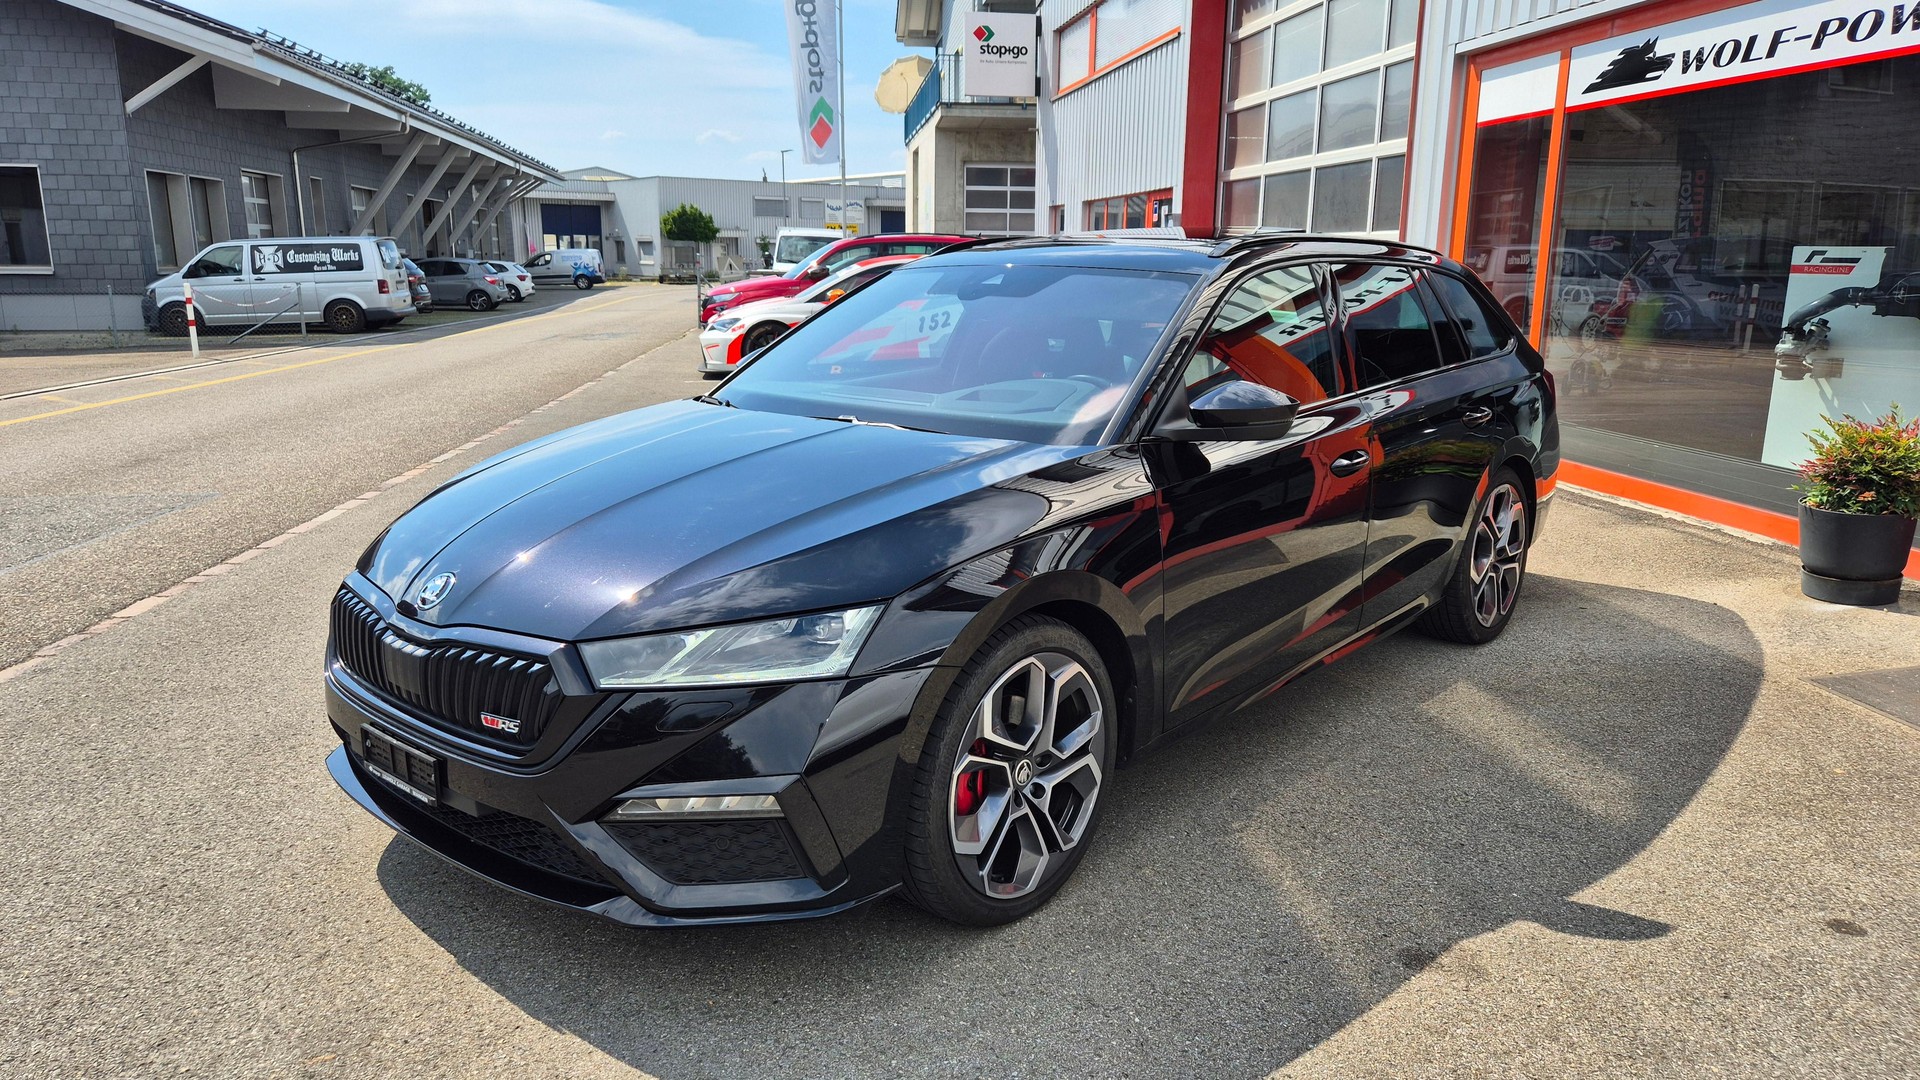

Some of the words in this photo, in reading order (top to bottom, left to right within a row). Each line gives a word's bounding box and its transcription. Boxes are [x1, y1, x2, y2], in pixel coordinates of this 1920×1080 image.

[980, 43, 1028, 59] stop+go
[287, 248, 330, 264] Customizing
[331, 248, 359, 262] Works
[1803, 266, 1850, 274] RACINGLINE
[918, 311, 951, 333] 152
